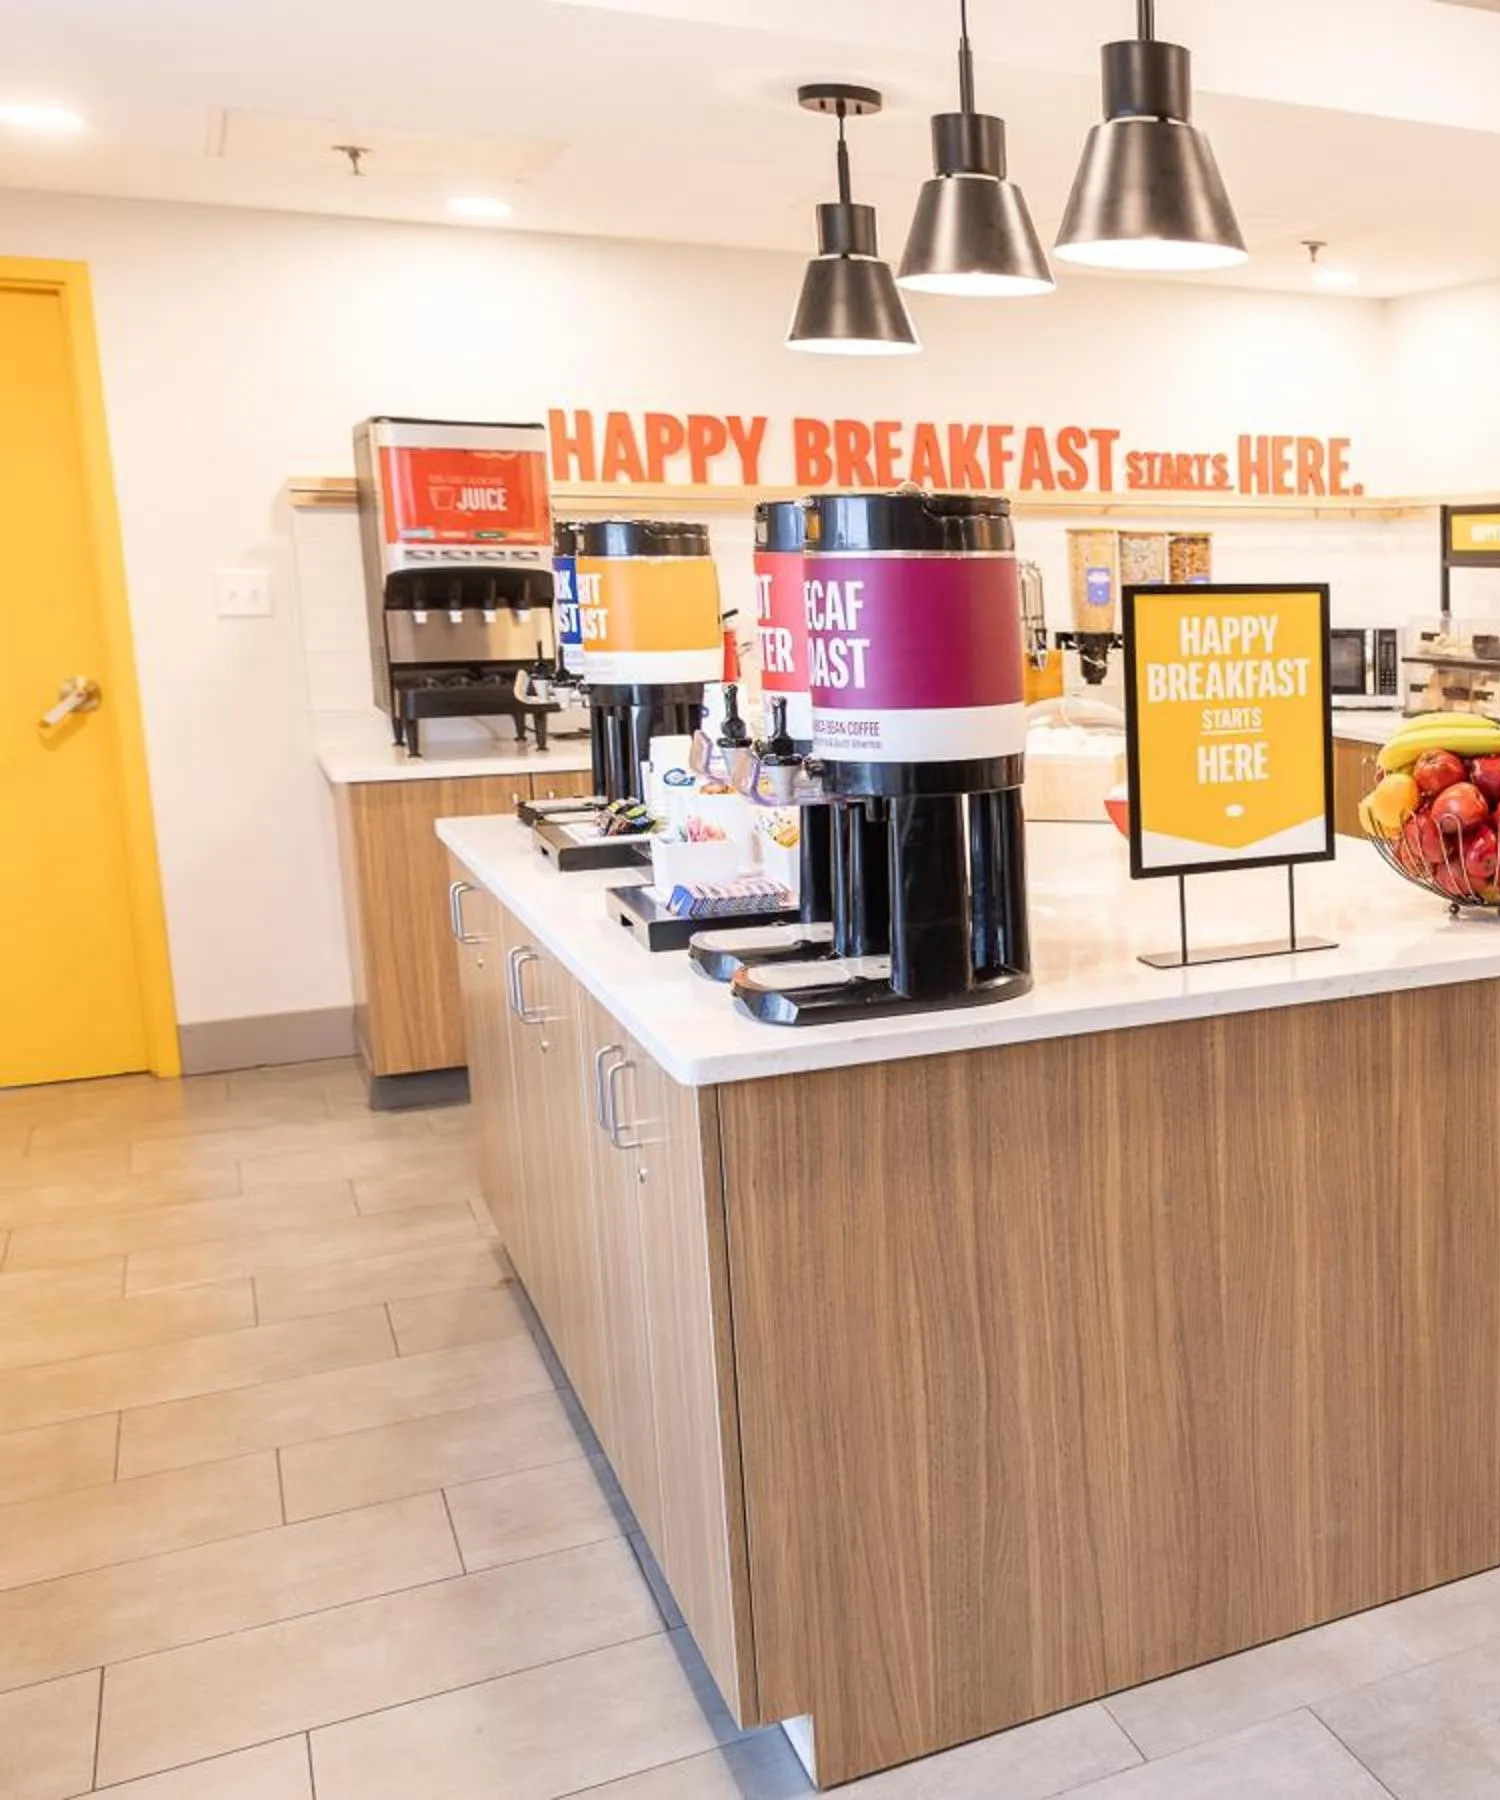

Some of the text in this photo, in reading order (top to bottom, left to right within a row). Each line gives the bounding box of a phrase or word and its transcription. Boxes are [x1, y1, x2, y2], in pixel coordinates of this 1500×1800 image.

[548, 409, 1364, 497] HAPPY BREAKFAST STARTS HERE.
[457, 488, 508, 511] JUICE
[1179, 614, 1279, 657] HAPPY
[1147, 658, 1311, 703] BREAKFAST
[847, 721, 880, 737] COFFEE
[1201, 707, 1263, 730] STARTS
[1197, 742, 1270, 785] HERE
